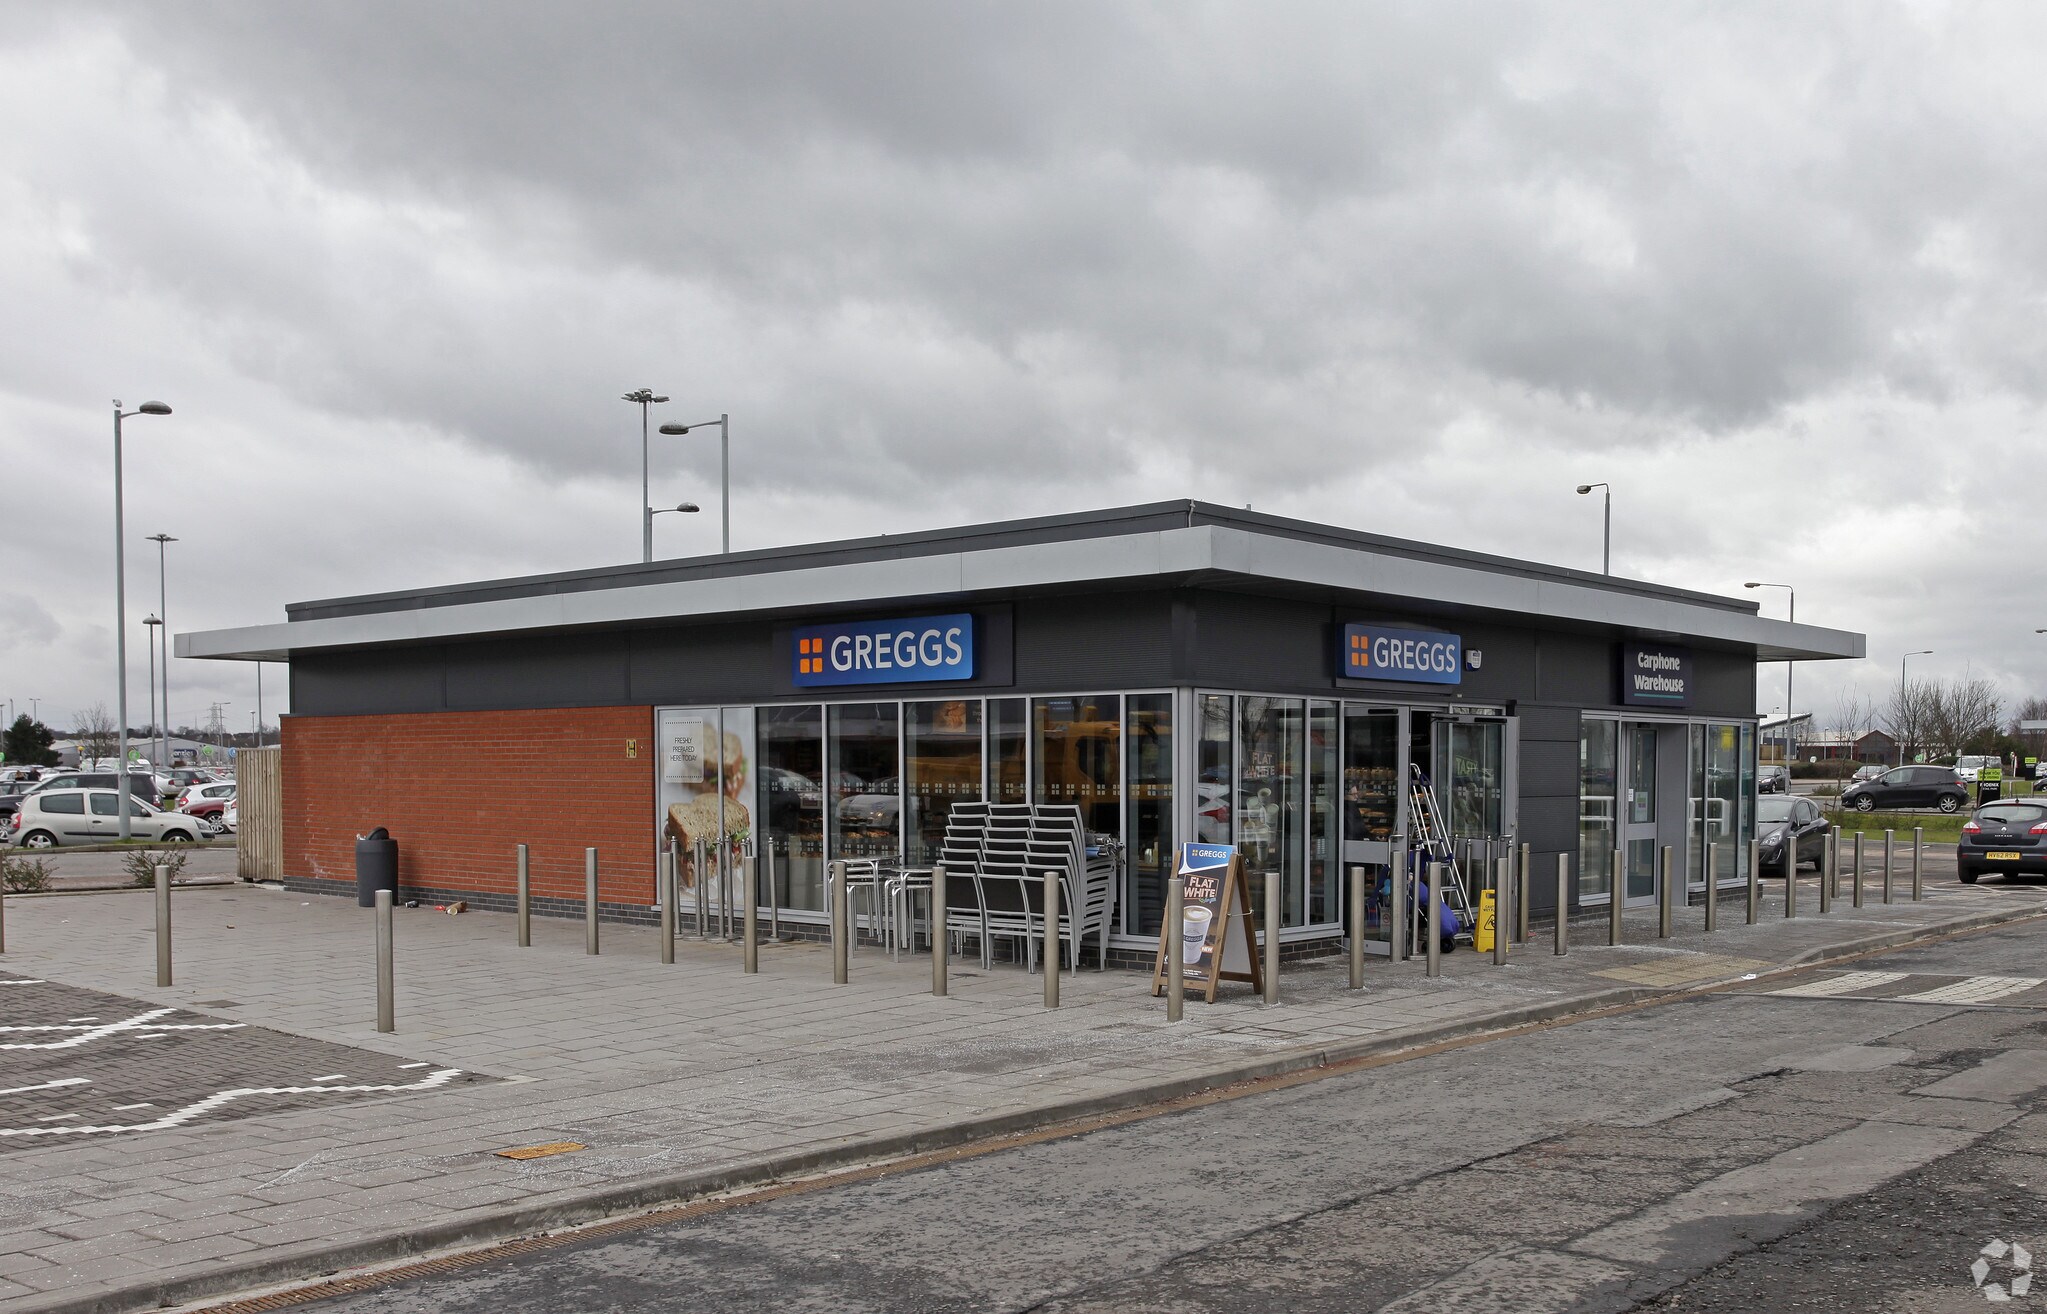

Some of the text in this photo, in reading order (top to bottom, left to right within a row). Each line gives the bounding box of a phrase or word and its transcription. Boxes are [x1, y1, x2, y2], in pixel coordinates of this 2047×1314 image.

[830, 627, 963, 672] GREGGS
[1373, 636, 1456, 673] GREGGS
[1637, 651, 1681, 672] Carphone
[1633, 674, 1684, 693] Warehouse
[672, 745, 695, 753] PREPARED
[1252, 751, 1273, 765] FLAT
[1198, 849, 1227, 859] GREGGS
[1189, 876, 1214, 888] FLAT
[1183, 886, 1216, 898] WHITE
